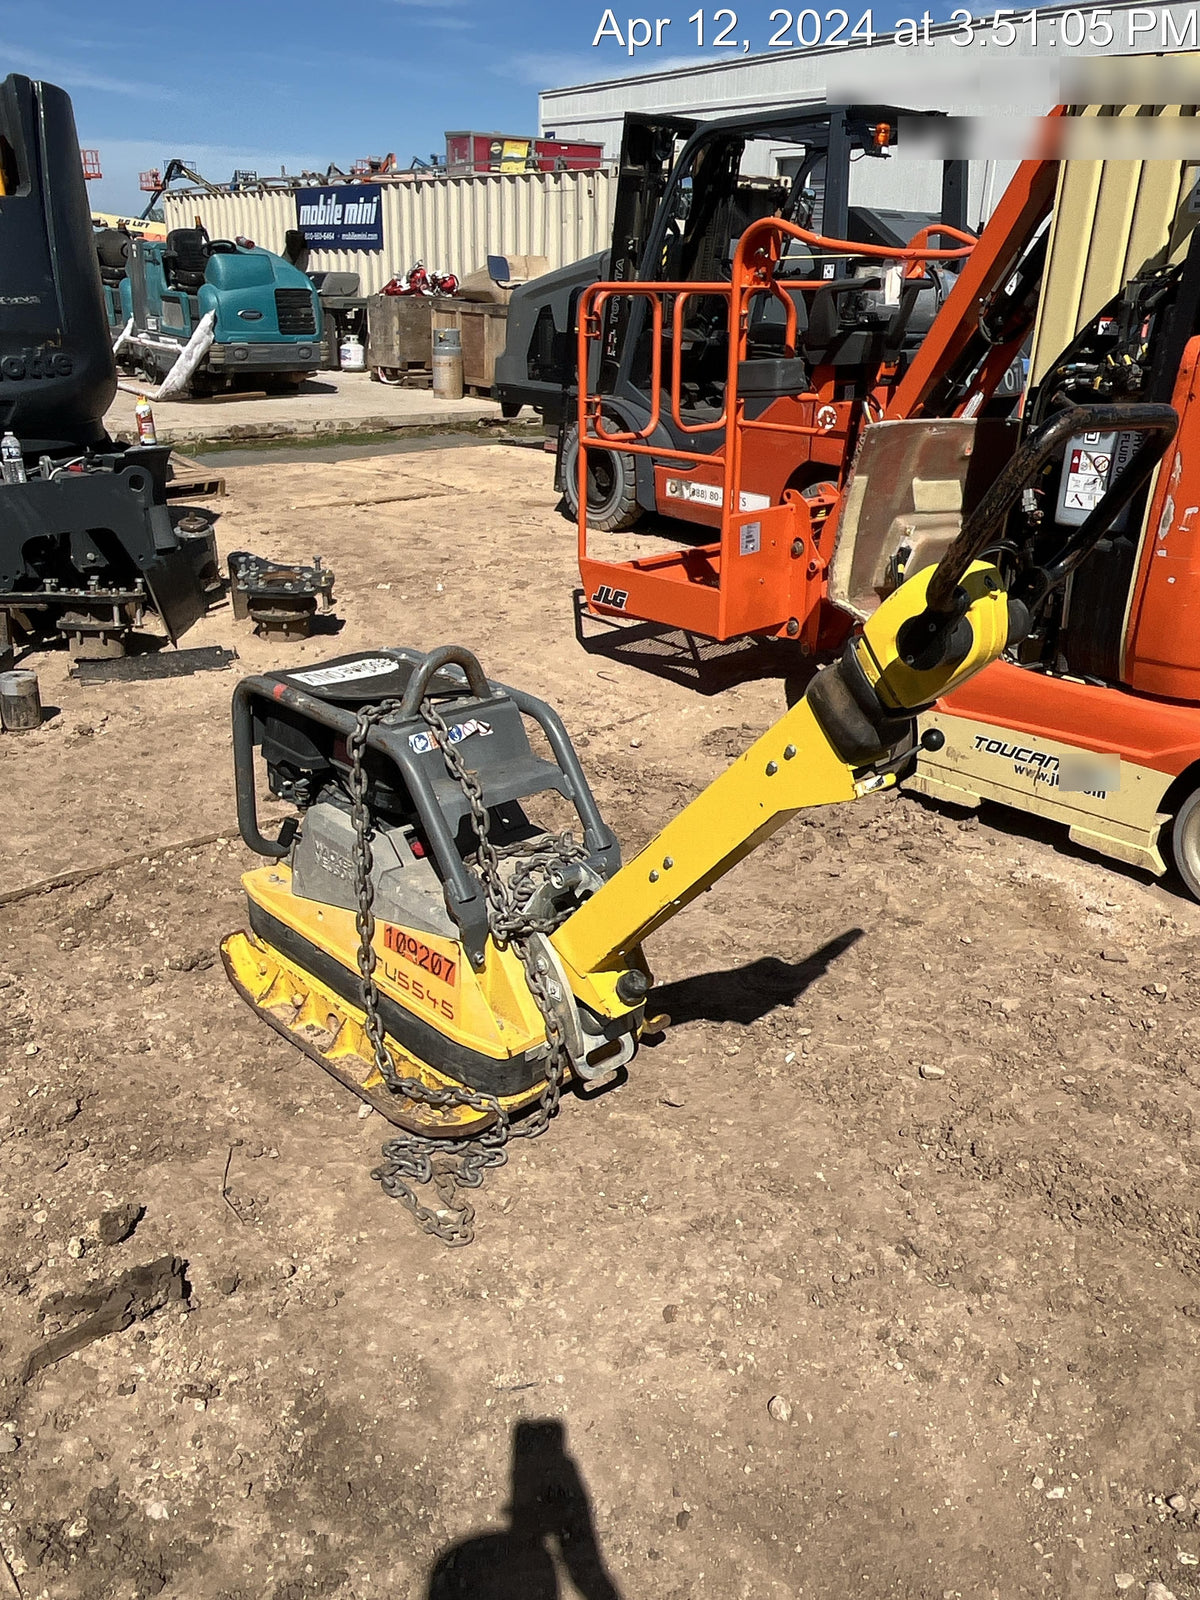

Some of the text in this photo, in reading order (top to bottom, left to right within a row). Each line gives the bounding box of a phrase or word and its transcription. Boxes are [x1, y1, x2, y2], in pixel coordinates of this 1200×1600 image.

[132, 221, 150, 229] LIFT
[300, 193, 379, 225] mobile mini
[610, 258, 624, 324] TOYTA
[1117, 433, 1130, 463] FLUID
[592, 585, 628, 609] JLG
[974, 735, 1060, 771] TOUCAN
[384, 926, 456, 982] 109207
